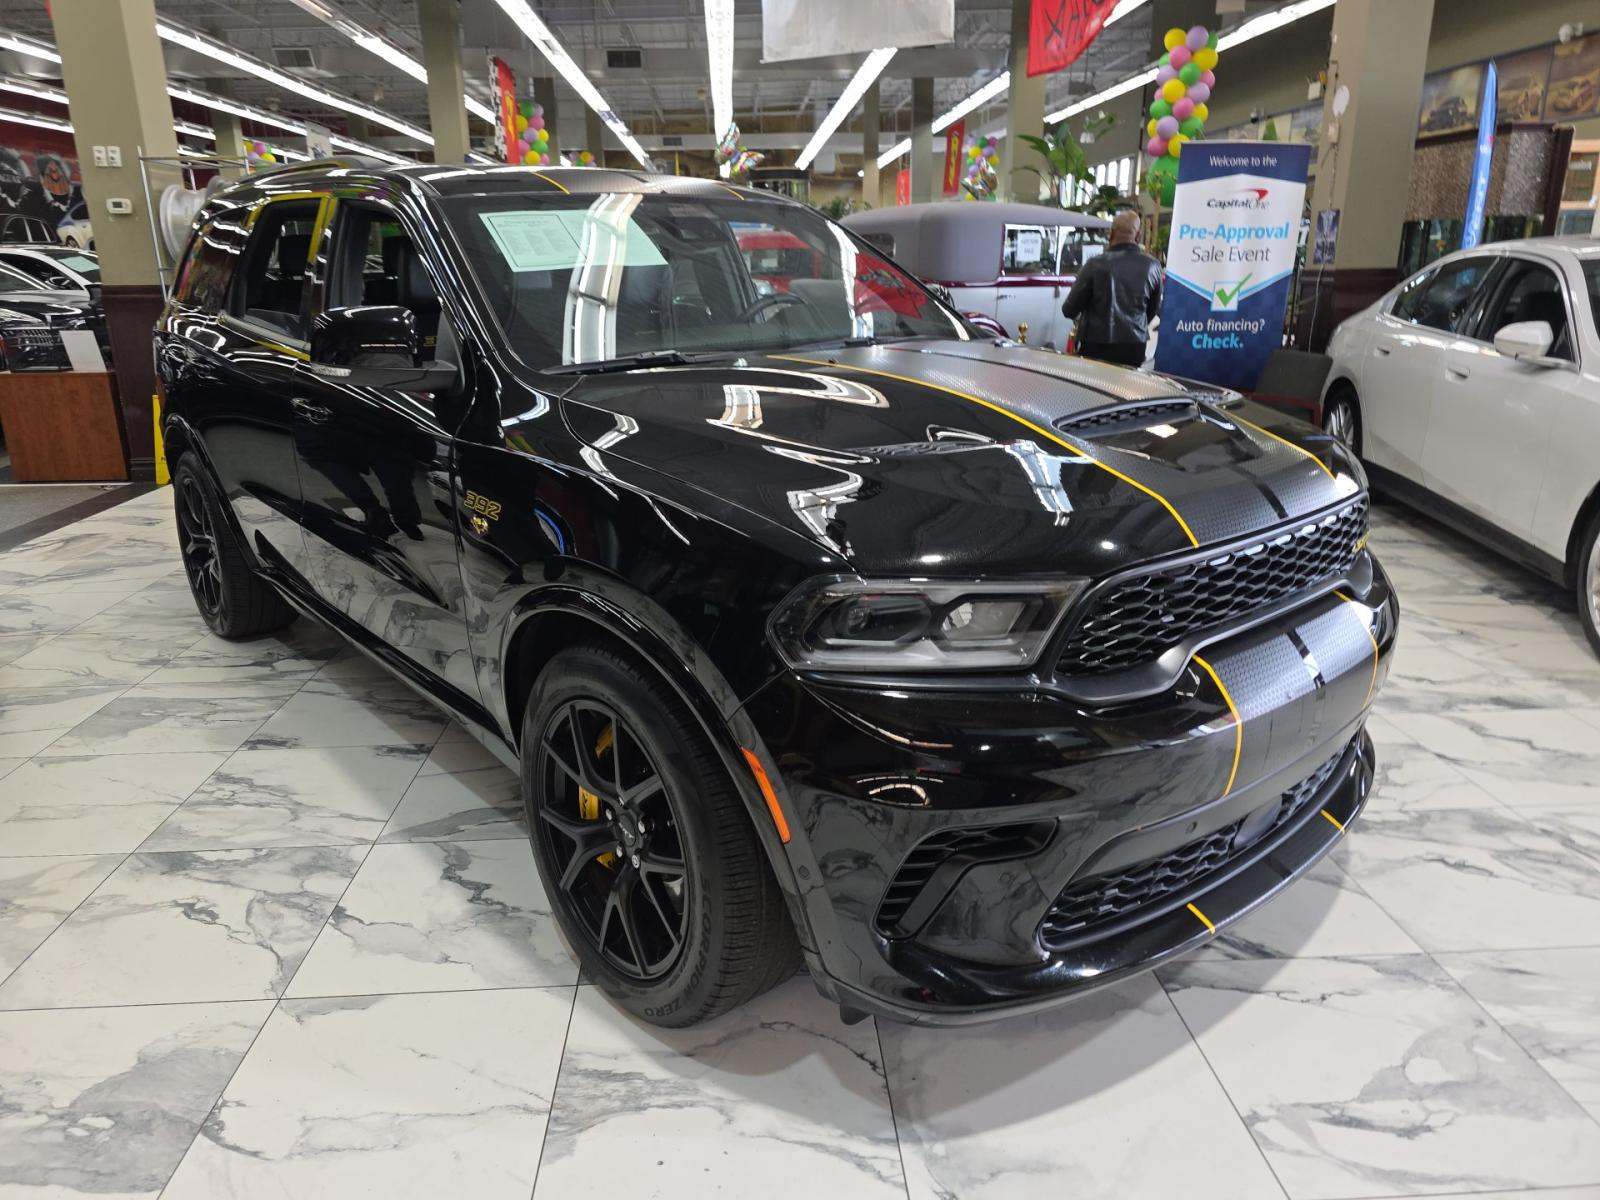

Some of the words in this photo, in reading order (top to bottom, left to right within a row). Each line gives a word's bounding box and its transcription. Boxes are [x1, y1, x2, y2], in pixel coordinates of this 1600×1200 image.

[1209, 155, 1249, 168] Welcome
[1251, 156, 1260, 167] to
[1262, 155, 1278, 167] the
[1179, 222, 1290, 242] Pre-Approval
[1191, 246, 1225, 263] Sale
[1228, 246, 1270, 262] Event
[1176, 319, 1204, 332] Auto
[1206, 319, 1266, 334] financing?
[1191, 334, 1244, 349] Check.
[464, 490, 502, 521] 392
